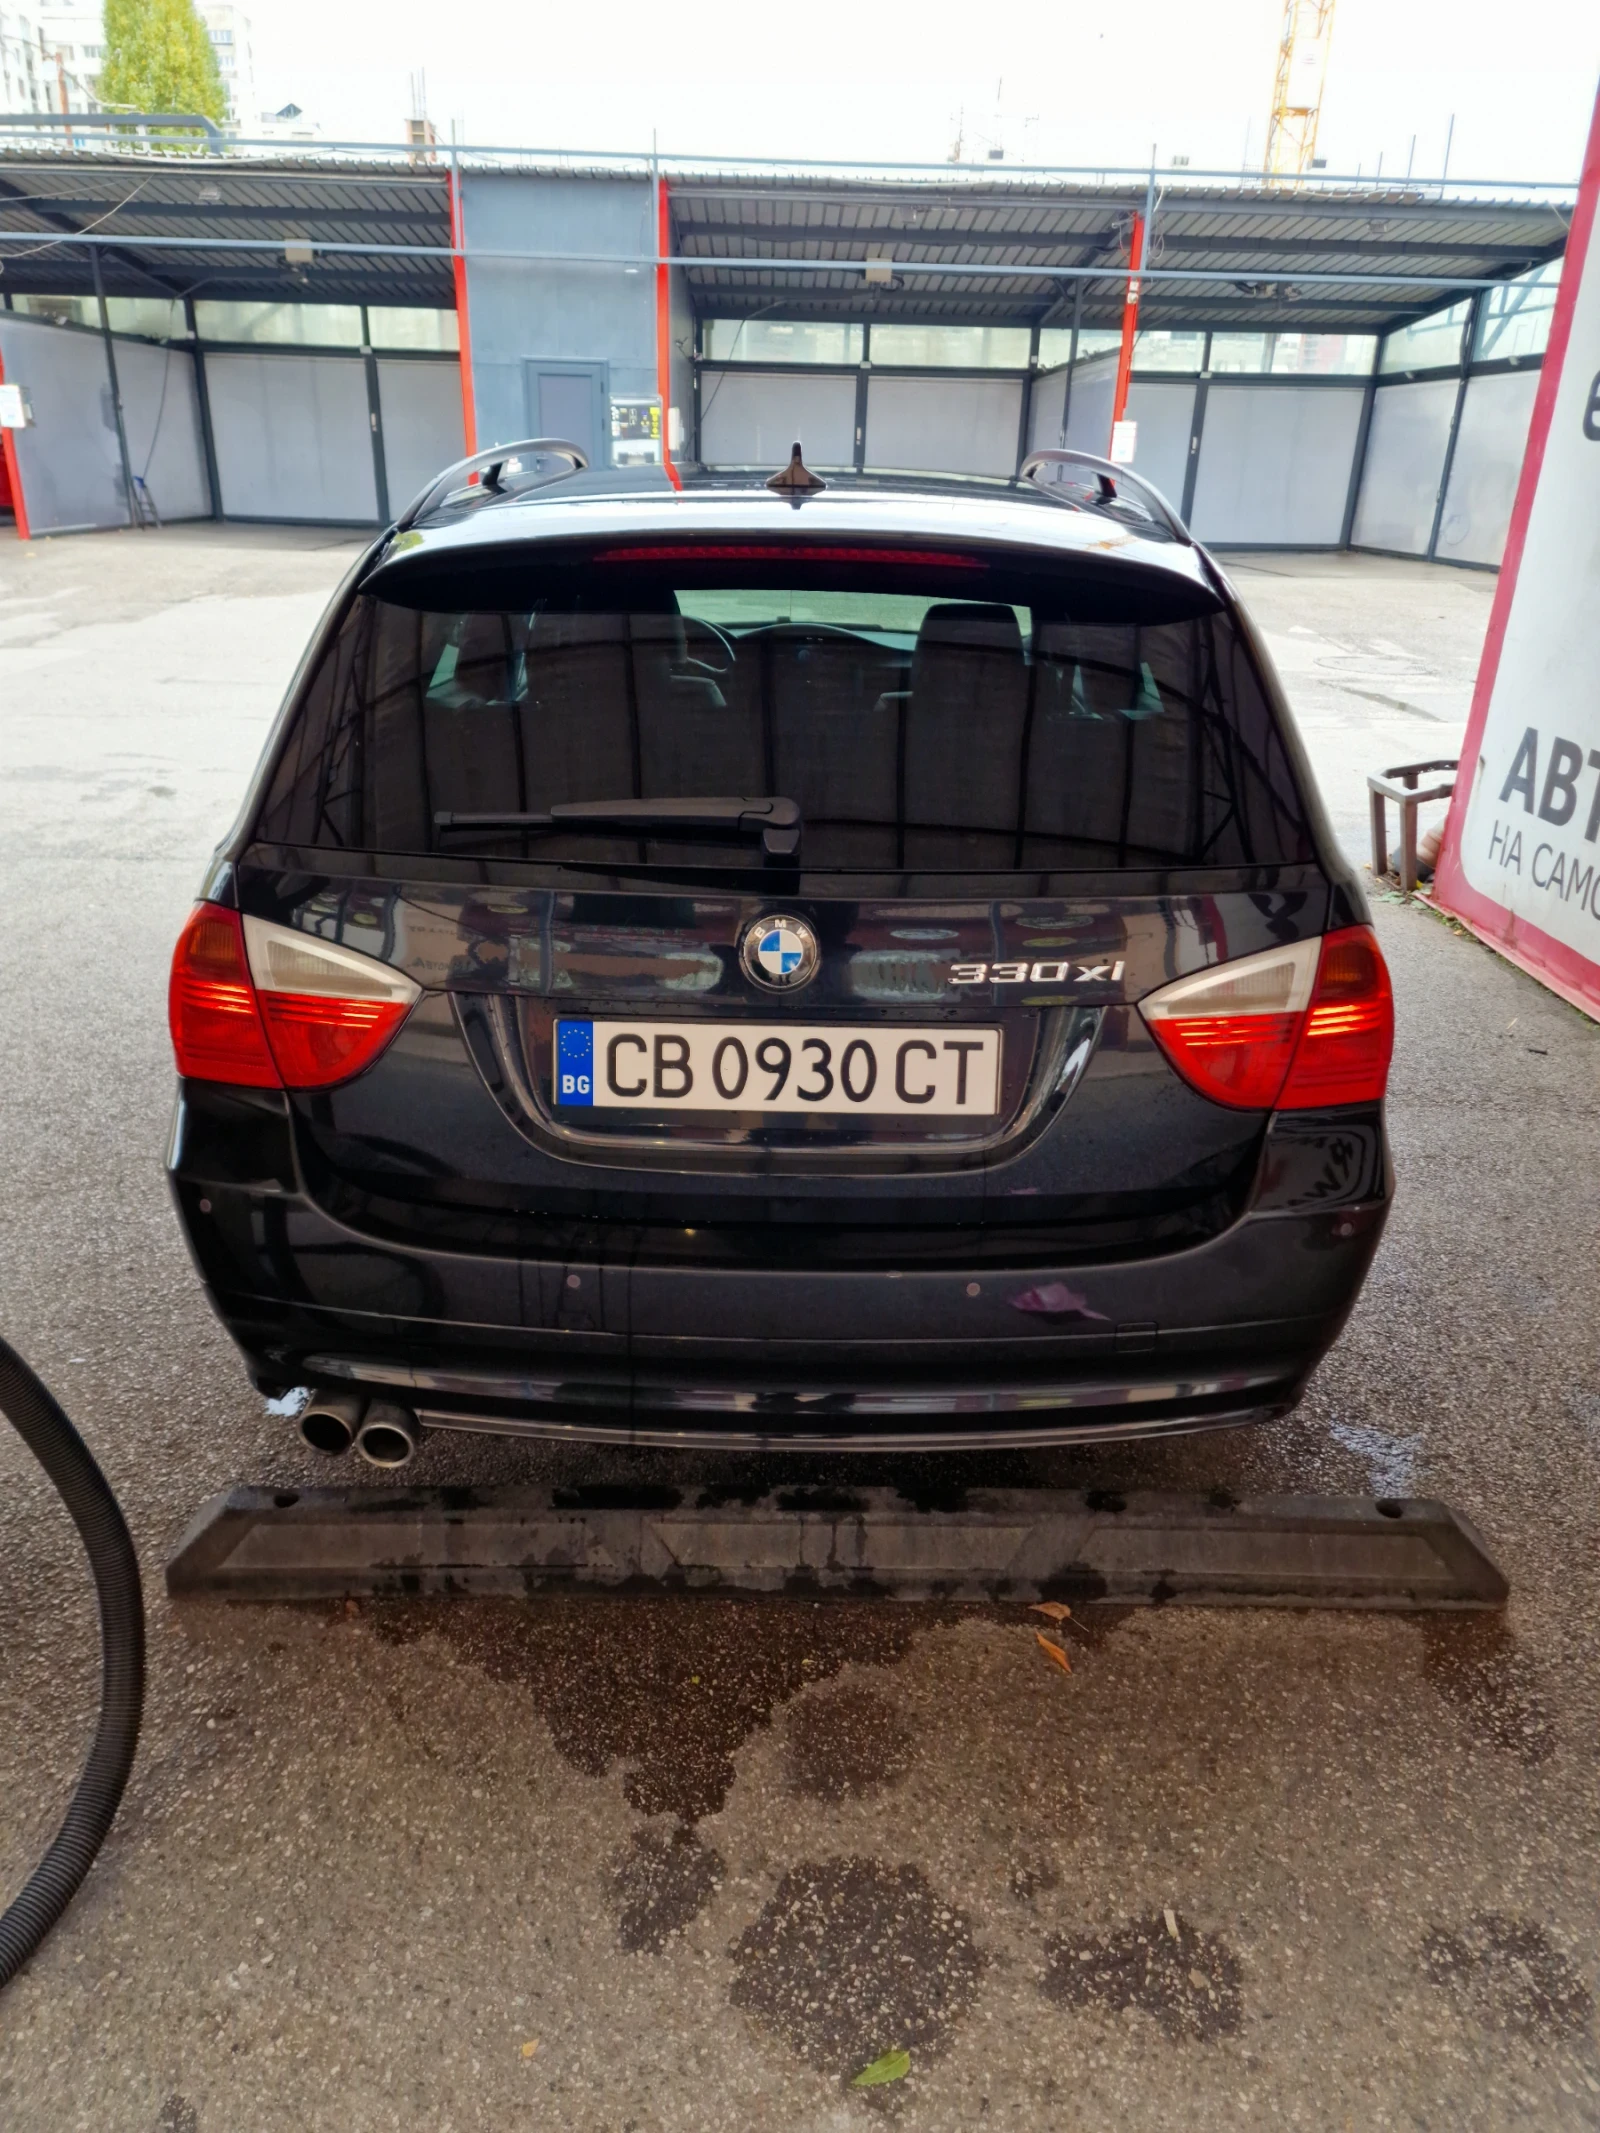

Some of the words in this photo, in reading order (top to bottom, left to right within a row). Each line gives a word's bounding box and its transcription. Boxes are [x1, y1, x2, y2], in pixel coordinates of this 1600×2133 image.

[1488, 819, 1522, 876] НА
[754, 918, 809, 939] BMW
[562, 1074, 590, 1094] BG
[711, 1036, 878, 1103] 0930
